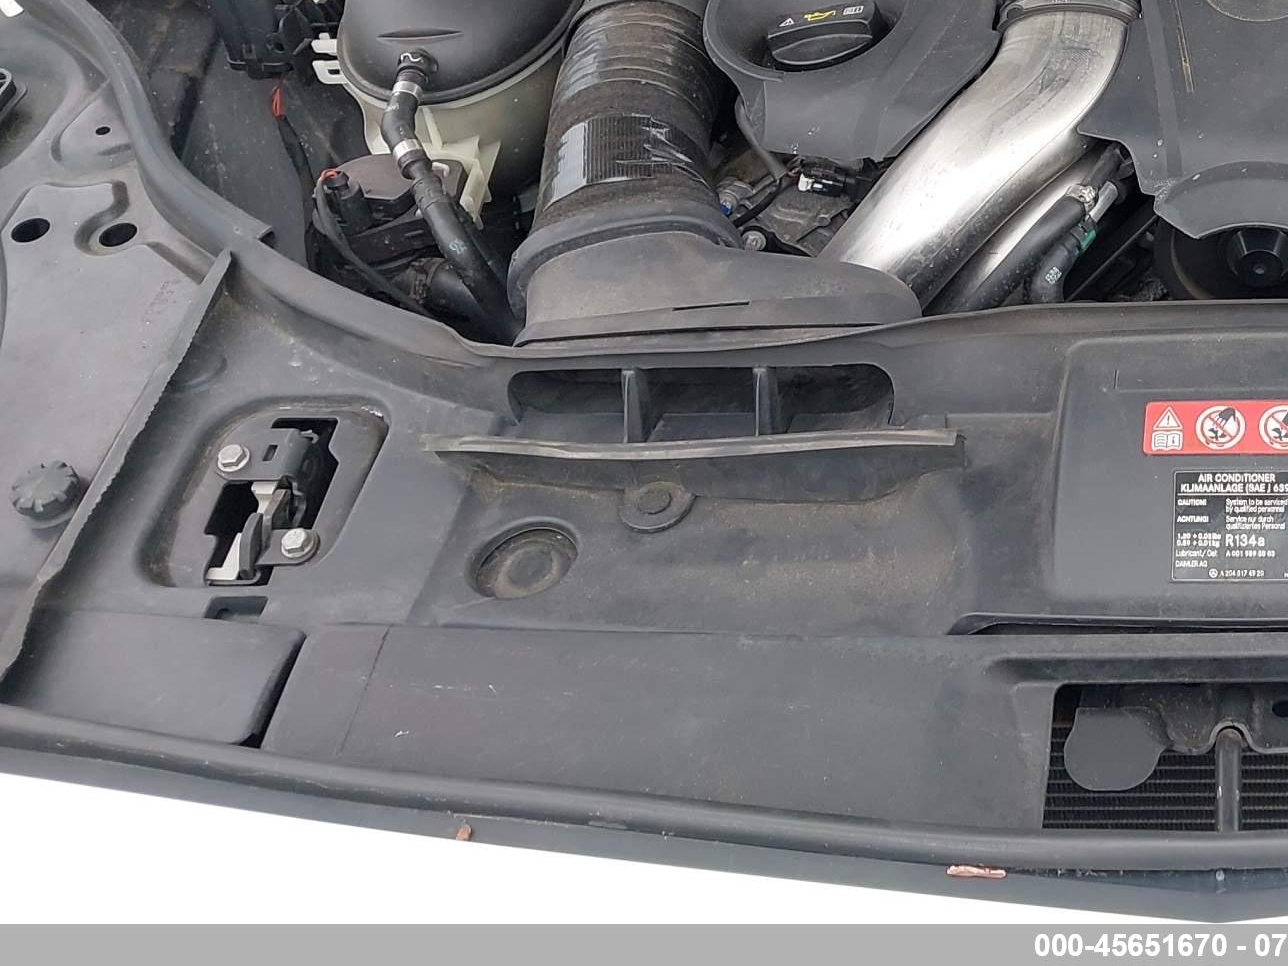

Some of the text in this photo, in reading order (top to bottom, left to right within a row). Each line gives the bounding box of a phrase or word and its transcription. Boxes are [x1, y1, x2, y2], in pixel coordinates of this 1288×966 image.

[1198, 473, 1276, 482] AIR CONDITIONER
[1180, 483, 1244, 492] KLIMAANLAGE
[1245, 483, 1265, 494] (SAE
[1226, 498, 1248, 507] System
[1226, 505, 1285, 514] by qualified personnel
[1176, 515, 1209, 523] ACHTUNG!
[1226, 515, 1247, 523] Service
[1258, 515, 1274, 523] durch
[1261, 522, 1286, 530] Personal
[1225, 533, 1265, 547] R134a
[1225, 549, 1231, 558] A
[1225, 569, 1236, 577] 204
